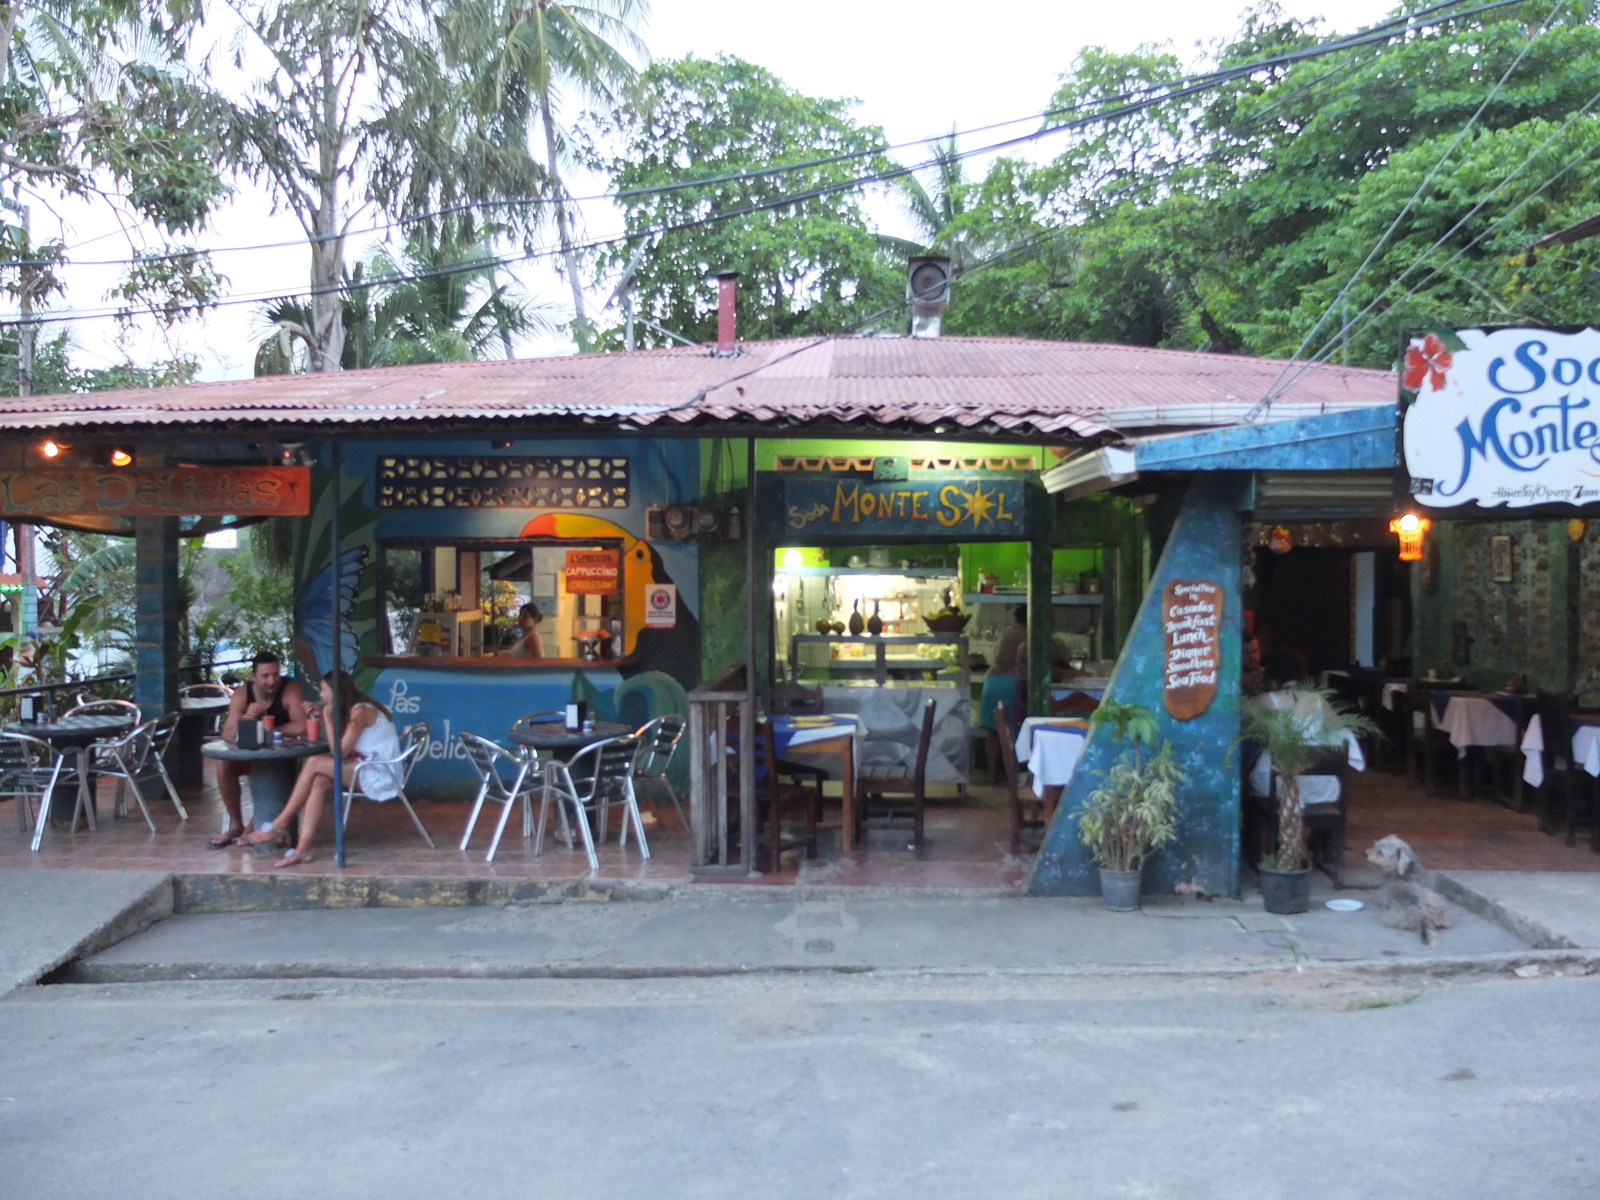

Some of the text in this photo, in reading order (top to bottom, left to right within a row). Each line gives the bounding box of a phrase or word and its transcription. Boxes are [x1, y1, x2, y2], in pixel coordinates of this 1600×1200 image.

[1436, 393, 1597, 496] Monte
[0, 473, 84, 512] Las
[789, 503, 830, 529] Soda
[830, 483, 929, 522] MONTE
[1169, 600, 1215, 618] Casados
[1165, 614, 1217, 633] Breakfast
[1172, 627, 1214, 646] Lunch
[1168, 645, 1212, 662] Dinner
[1165, 658, 1215, 674] Smoothies
